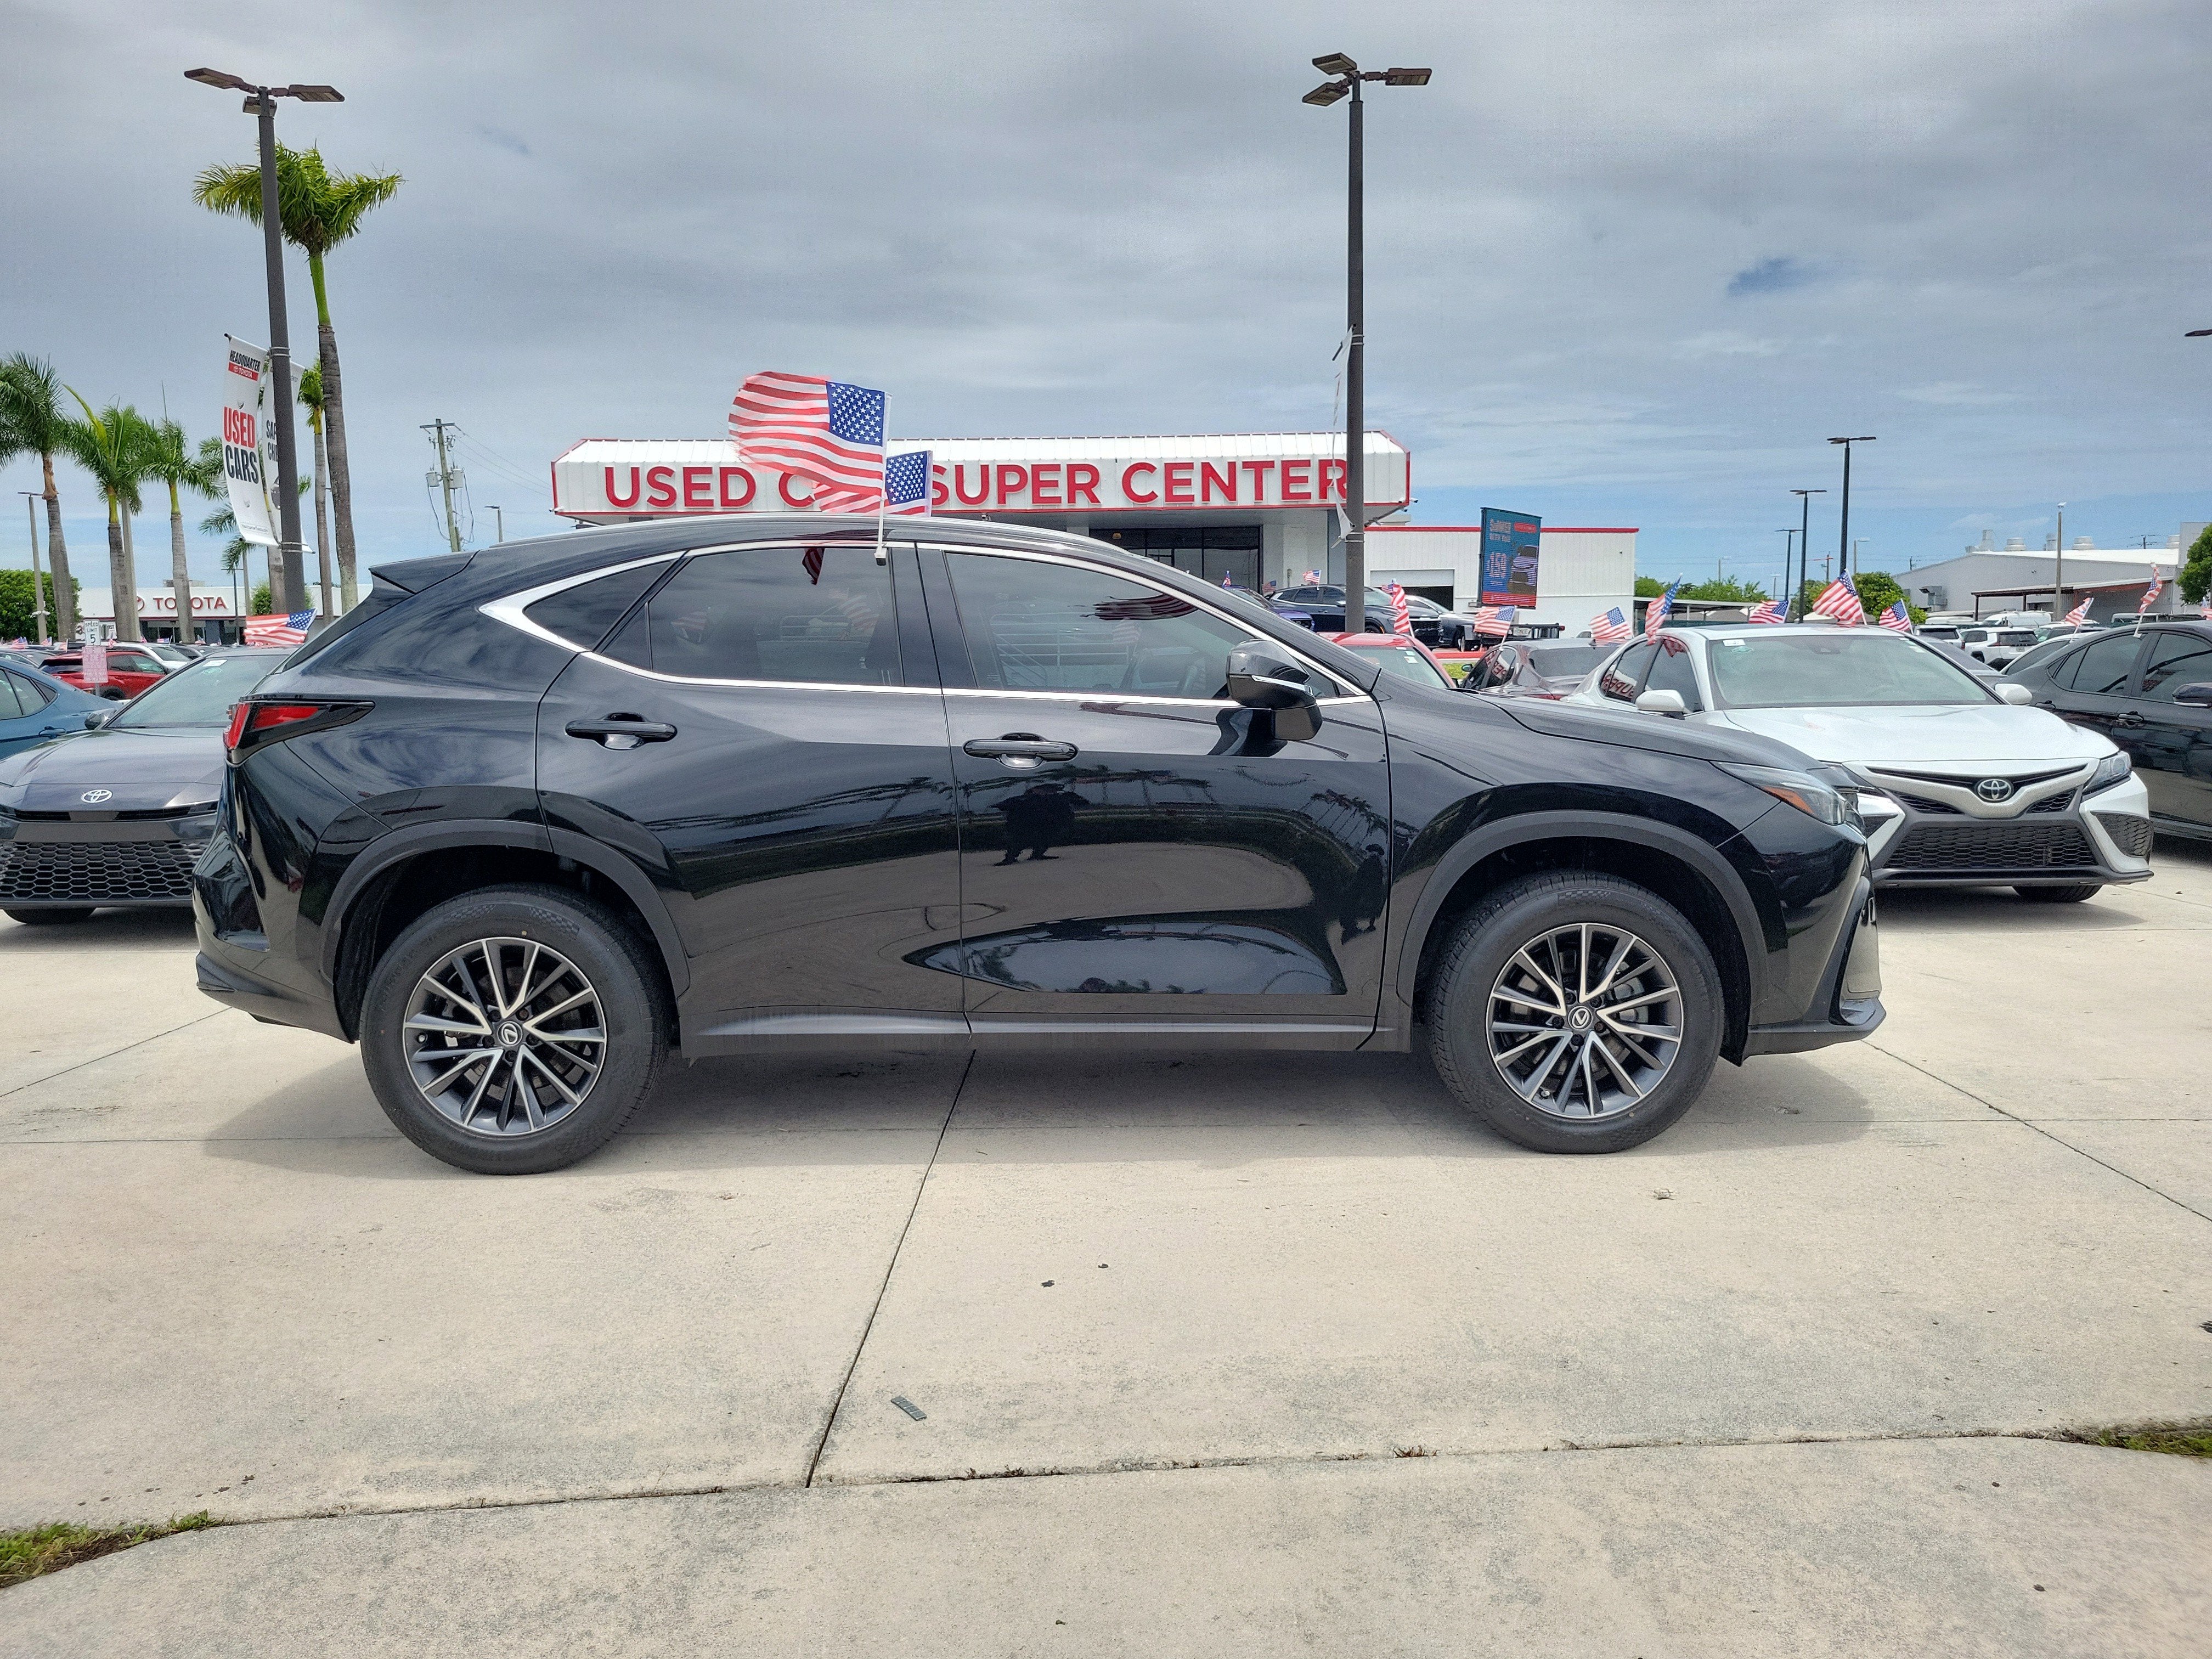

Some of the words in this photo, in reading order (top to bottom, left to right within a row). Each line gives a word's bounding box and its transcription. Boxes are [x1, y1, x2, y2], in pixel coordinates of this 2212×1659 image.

[229, 350, 261, 372] HEADQUARTER
[238, 368, 253, 379] TOYOTA
[224, 406, 256, 448] USED
[225, 445, 259, 484] CARS
[604, 466, 757, 508] USED
[932, 464, 1101, 506] SUPER
[1121, 459, 1347, 504] CENTER
[153, 597, 228, 610] TOOTA
[90, 634, 96, 643] 5
